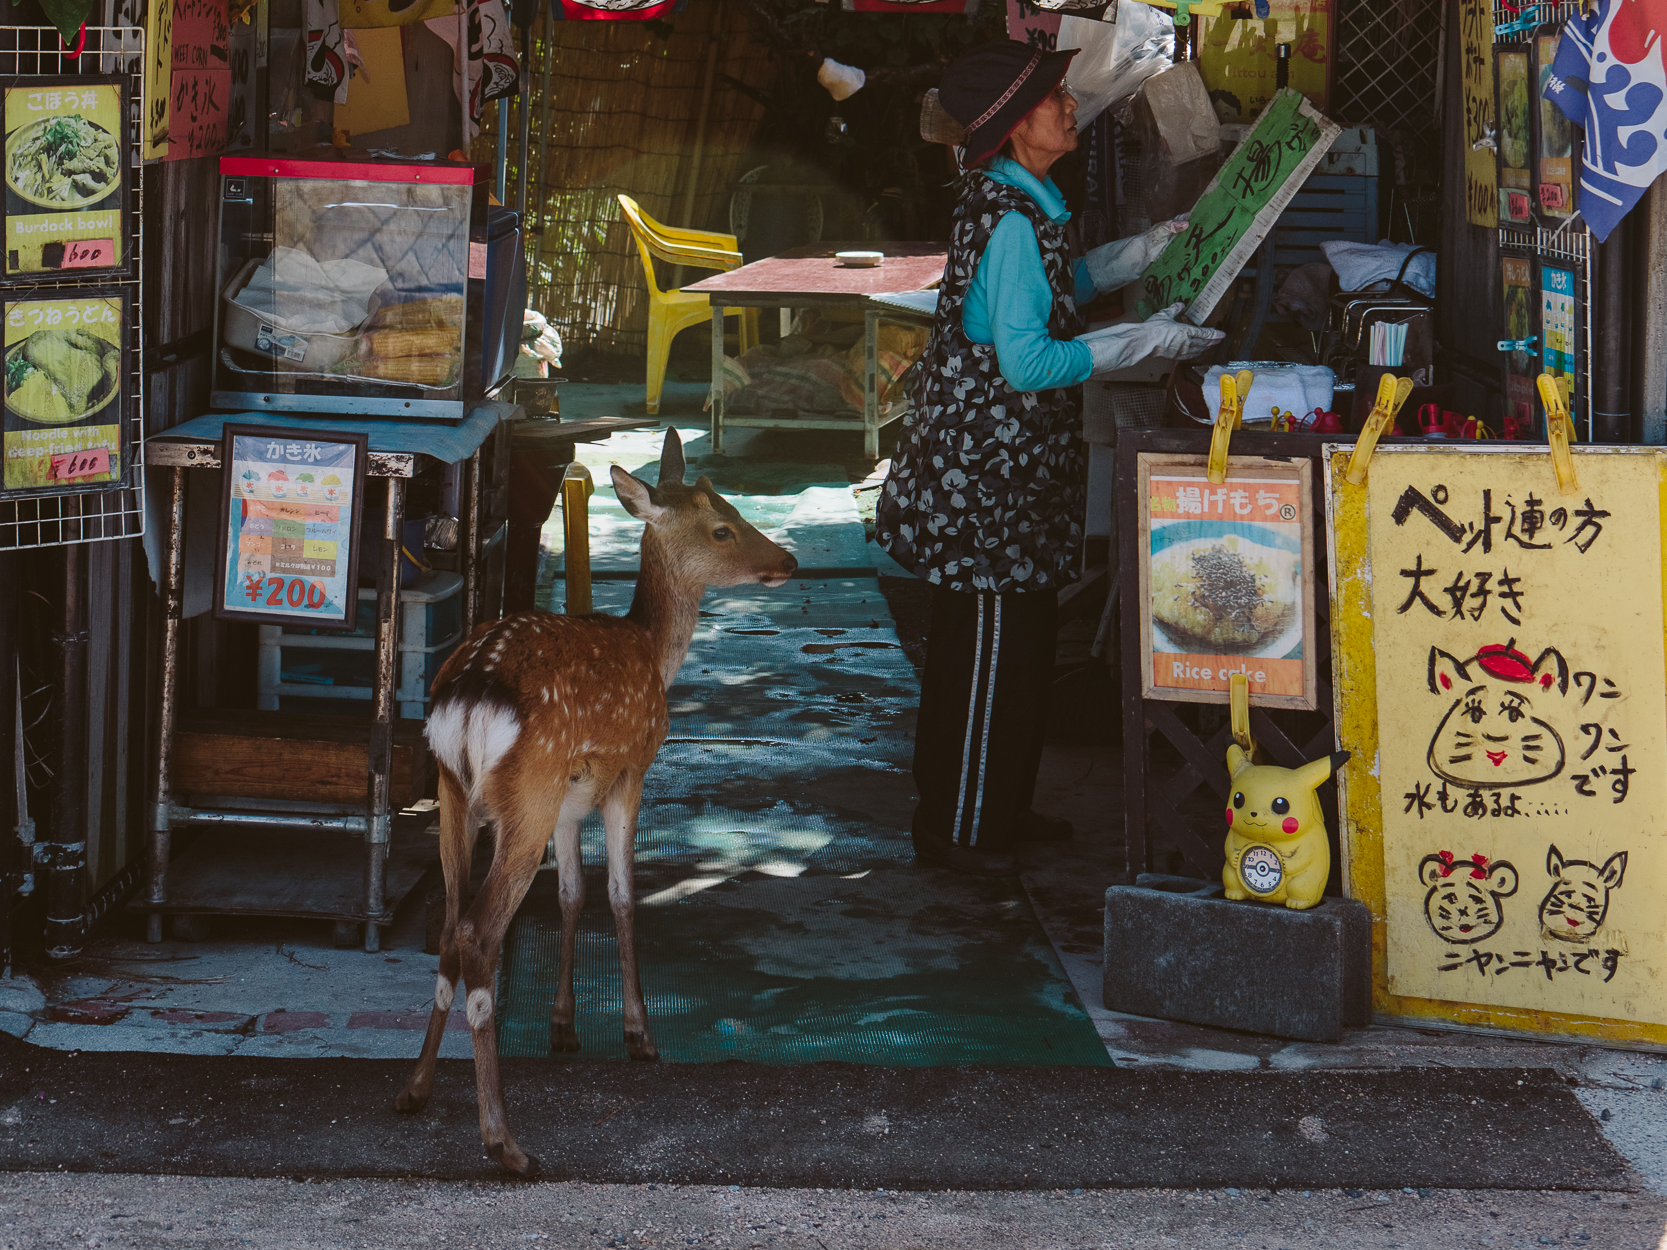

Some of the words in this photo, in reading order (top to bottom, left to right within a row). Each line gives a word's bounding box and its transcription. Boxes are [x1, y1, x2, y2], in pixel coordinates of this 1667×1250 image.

[191, 45, 208, 68] CORN
[176, 75, 220, 123] かき氷
[16, 218, 73, 235] Burdock
[78, 215, 113, 231] bowl
[68, 243, 102, 263] 600
[1550, 270, 1567, 290] かき氷
[21, 429, 69, 442] Noodle
[73, 425, 100, 438] with
[8, 441, 82, 459] deep-fried
[266, 441, 322, 463] かき氷
[1150, 496, 1176, 512] 名物
[1176, 486, 1280, 515] 揚げもち
[245, 575, 327, 609] ¥200
[1396, 553, 1525, 626] 大好き
[1172, 661, 1212, 680] Rice
[1570, 753, 1637, 805] です
